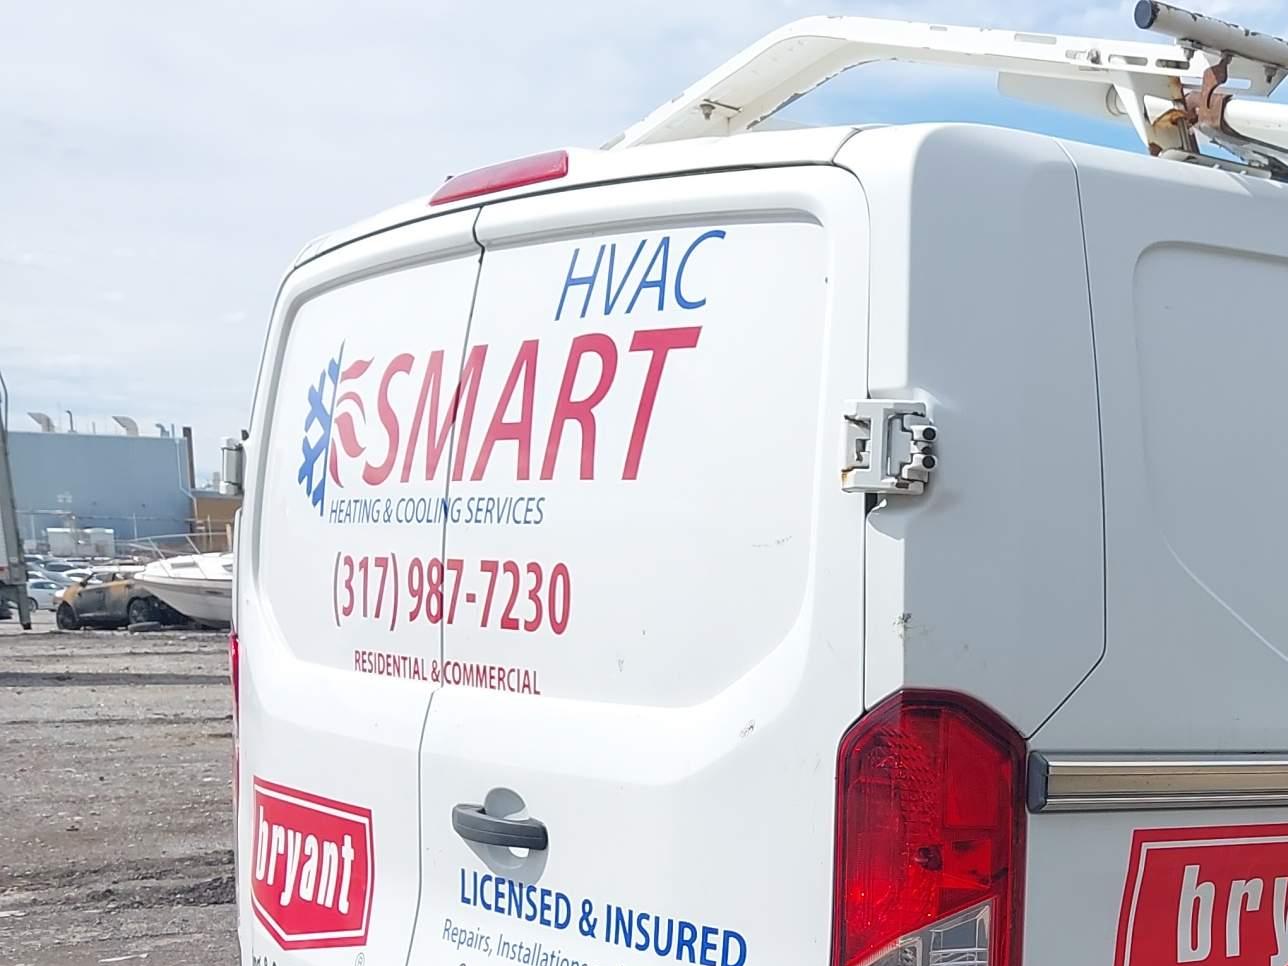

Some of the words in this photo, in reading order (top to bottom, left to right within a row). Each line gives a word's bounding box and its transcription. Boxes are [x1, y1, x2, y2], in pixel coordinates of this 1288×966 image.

[554, 230, 726, 321] HVAC
[361, 326, 703, 485] SMART
[329, 498, 381, 524] HEATING
[383, 498, 393, 524] &
[396, 497, 462, 524] COOLING
[465, 497, 546, 525] SERVICES
[333, 552, 399, 632] (317)
[408, 556, 572, 636] 987-7230
[355, 650, 428, 682] RESIDENTIAL
[431, 659, 441, 684] &
[443, 660, 541, 696] COMMERCIAL
[255, 804, 355, 915] bryant
[442, 918, 493, 957] Repairs,
[459, 868, 572, 931] LICENSED
[579, 899, 598, 939] &
